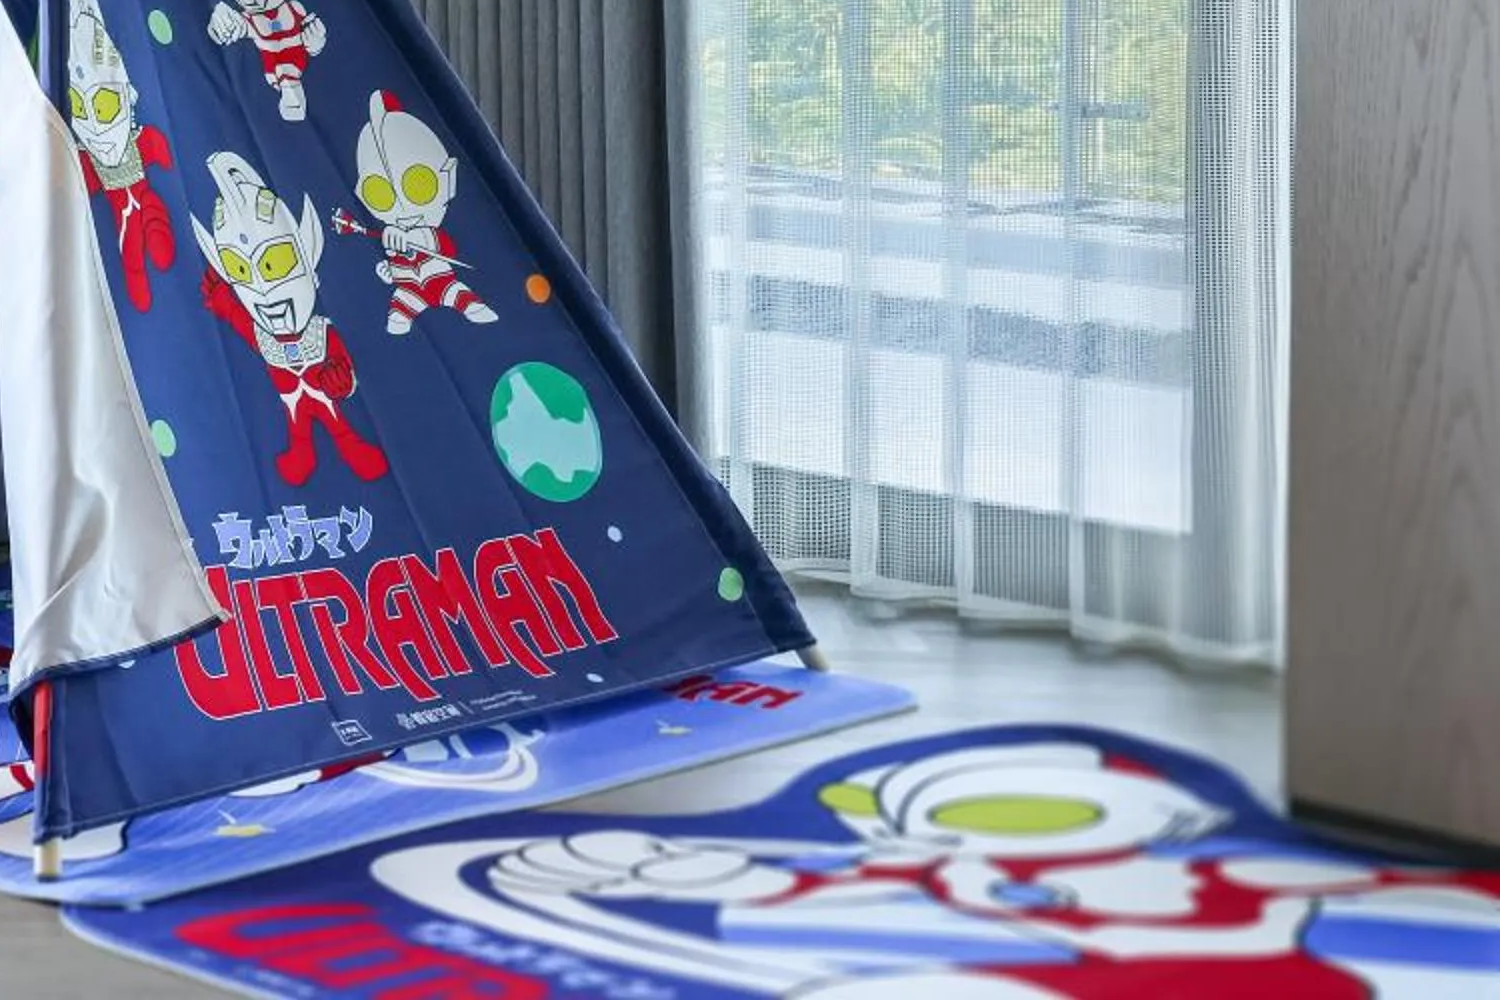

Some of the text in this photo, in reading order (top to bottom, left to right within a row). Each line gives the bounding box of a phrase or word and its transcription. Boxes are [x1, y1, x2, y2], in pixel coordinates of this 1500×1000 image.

[211, 504, 373, 569] ウルトラマン
[173, 526, 619, 721] ULTRAMAN
